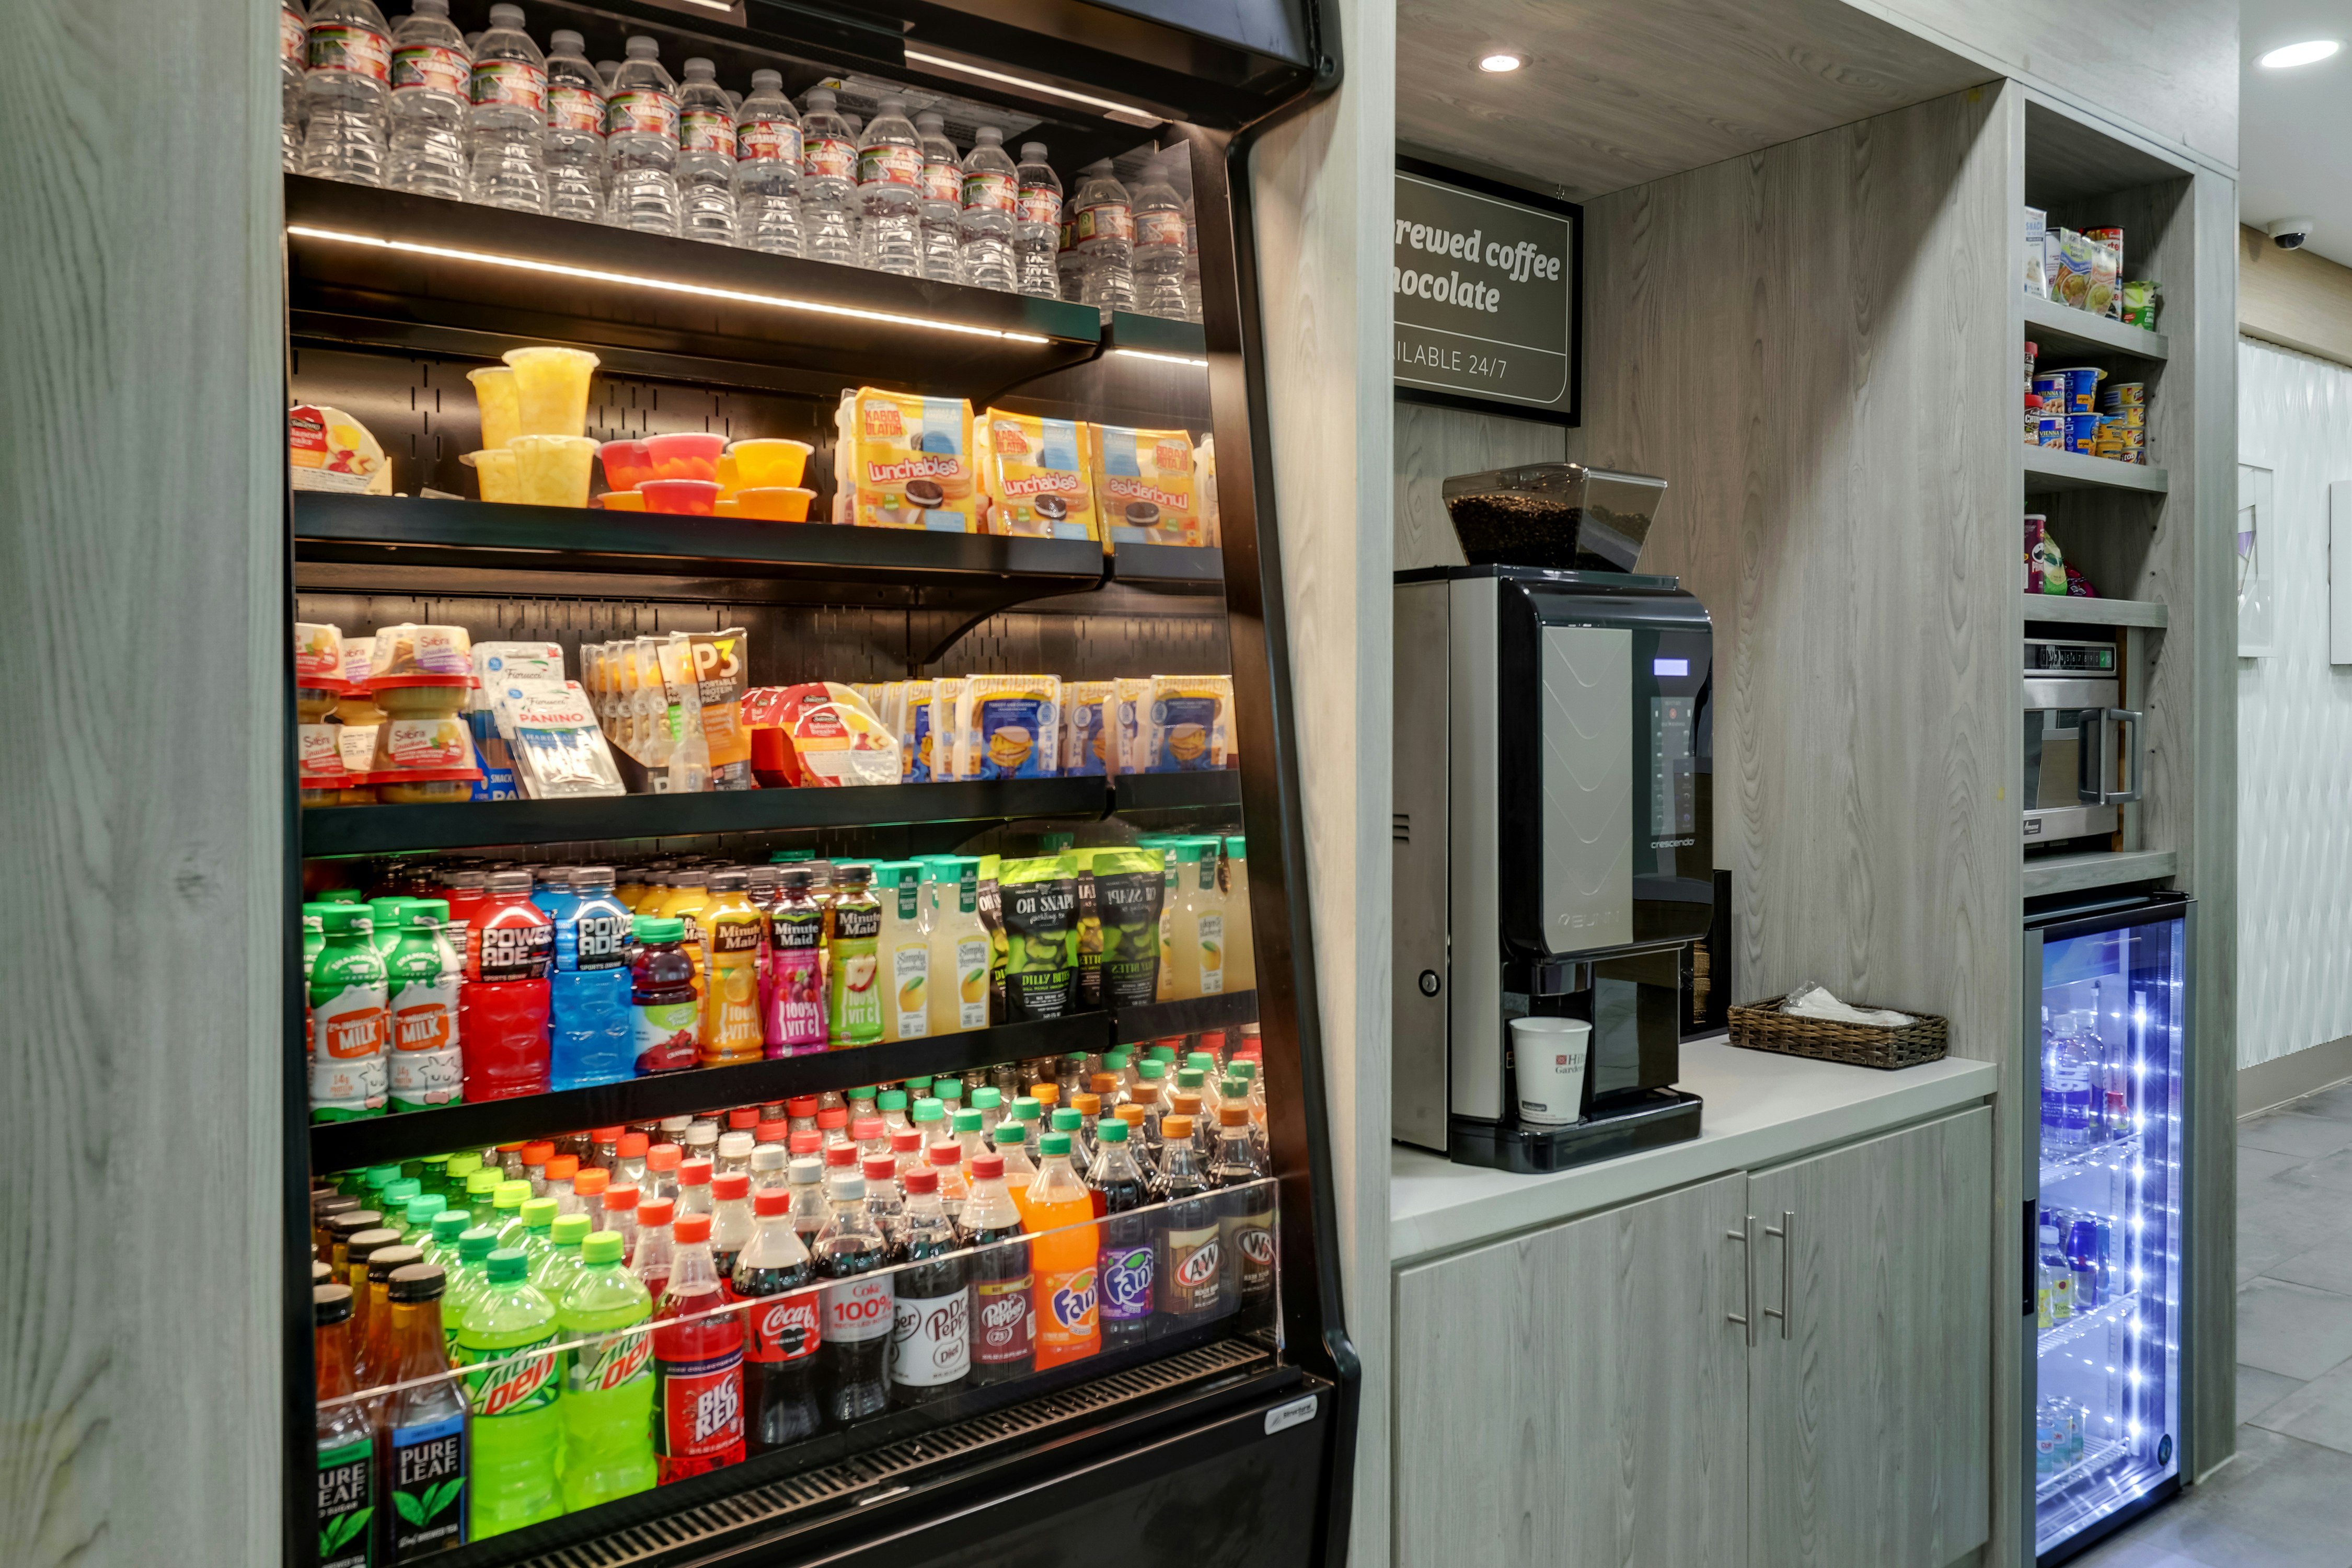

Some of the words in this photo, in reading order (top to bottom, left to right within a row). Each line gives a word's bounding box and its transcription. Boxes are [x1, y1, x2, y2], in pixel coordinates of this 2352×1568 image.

[1394, 218, 1482, 263] rewed
[1485, 241, 1561, 283] coffee
[1394, 267, 1501, 313] ocolate
[1394, 341, 1461, 372] ILABLE
[1469, 355, 1507, 378] 24/7
[291, 429, 322, 440] lanced
[868, 456, 960, 482] Lunchables
[1002, 472, 1078, 496] Lunchables
[691, 638, 739, 682] P3
[518, 713, 585, 724] PANINO
[490, 773, 513, 783] SNACK
[1650, 838, 1695, 849] crescendo
[1016, 897, 1038, 914] OH
[1040, 895, 1075, 912] SNAP!
[578, 913, 633, 938] POWE
[839, 912, 881, 926] Minute
[845, 921, 877, 936] Maid
[481, 924, 553, 948] POWER
[719, 924, 761, 940] Minute
[775, 922, 819, 936] Minute
[579, 934, 622, 956] ADE
[725, 935, 759, 950] Maid
[780, 933, 814, 947] Maid
[481, 946, 529, 967] ADE
[579, 963, 602, 972] SPORTS
[1022, 972, 1051, 986] DILLY
[729, 1005, 754, 1021] 100
[786, 1001, 814, 1019] 100%
[848, 1009, 865, 1025] VIT
[867, 1008, 874, 1022] C
[338, 1023, 378, 1052] MILK
[401, 1016, 441, 1044] MILK
[729, 1024, 749, 1040] VIT
[786, 1020, 806, 1037] VIT
[807, 1019, 815, 1035] C
[1555, 1065, 1584, 1074] Garde
[834, 1295, 892, 1322] 100%
[982, 1301, 1024, 1329] Pepper
[941, 1344, 959, 1363] Diet
[698, 1373, 734, 1414] BIG
[696, 1391, 738, 1443] RED
[400, 1437, 458, 1468] PURE
[318, 1462, 366, 1490] URE
[318, 1479, 365, 1508] EAF.
